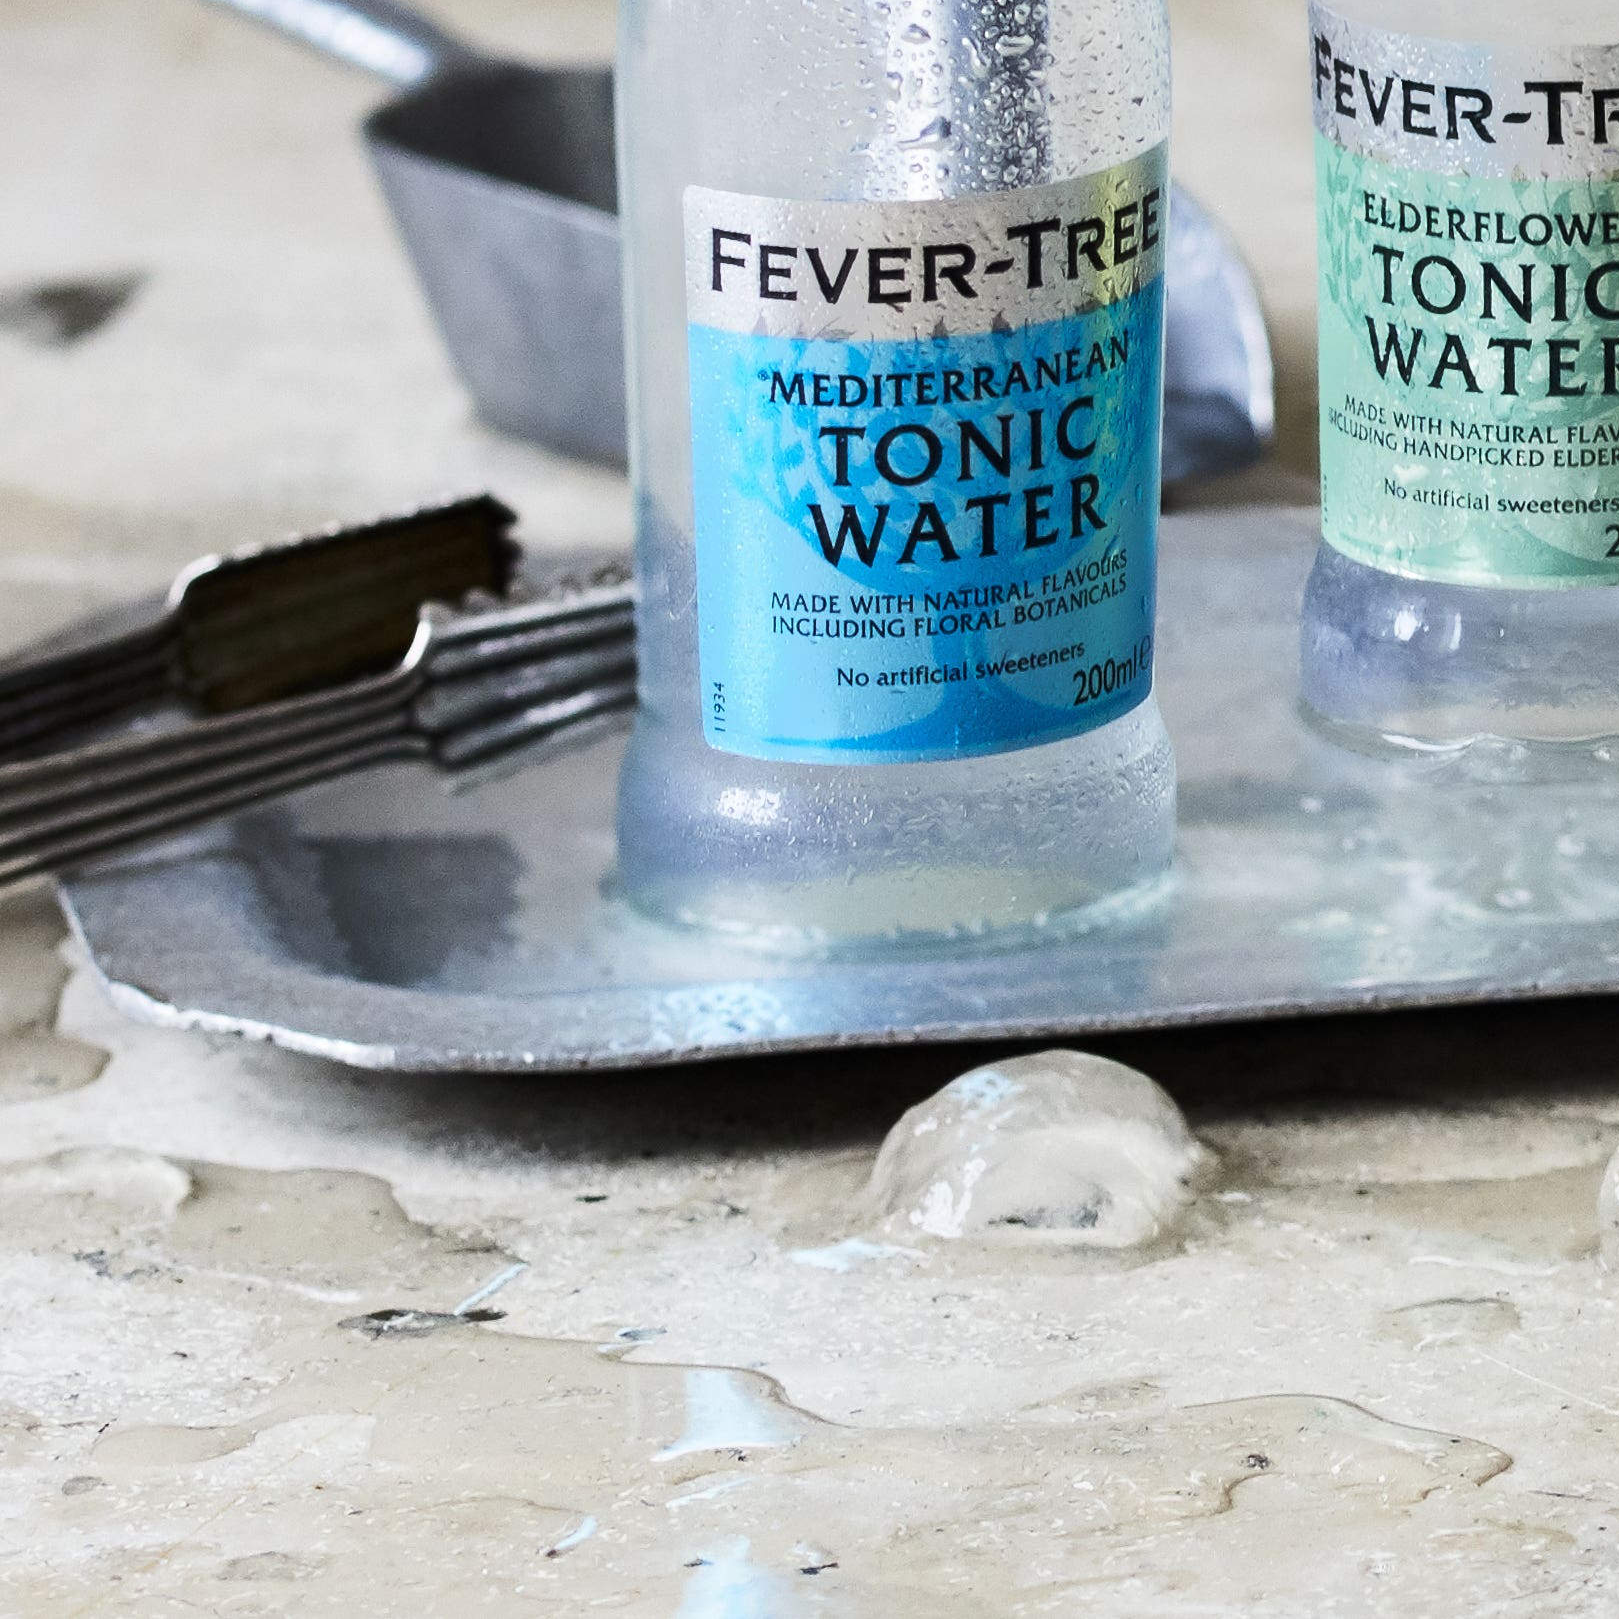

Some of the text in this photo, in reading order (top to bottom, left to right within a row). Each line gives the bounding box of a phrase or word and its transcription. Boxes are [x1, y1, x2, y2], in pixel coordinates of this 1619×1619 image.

[711, 191, 1160, 305] FEVER-TREE
[768, 331, 1129, 408] MEDITERRANEAN
[819, 397, 1099, 487] TONIC
[1344, 394, 1388, 424] MADE
[1393, 411, 1443, 436] WITH
[1450, 421, 1559, 444] NATURAL
[1403, 435, 1545, 467] HANDPICKED
[807, 474, 1108, 568] WATER
[1384, 479, 1406, 500] No
[1412, 487, 1490, 512] artificial
[771, 550, 1128, 615] MADE WITH NATURAL FLAVOURS
[771, 576, 1127, 638] INCLUDING FLORAL BOTANICALS
[836, 641, 1086, 687] No artificial sweeteners
[1072, 656, 1141, 706] 200ml
